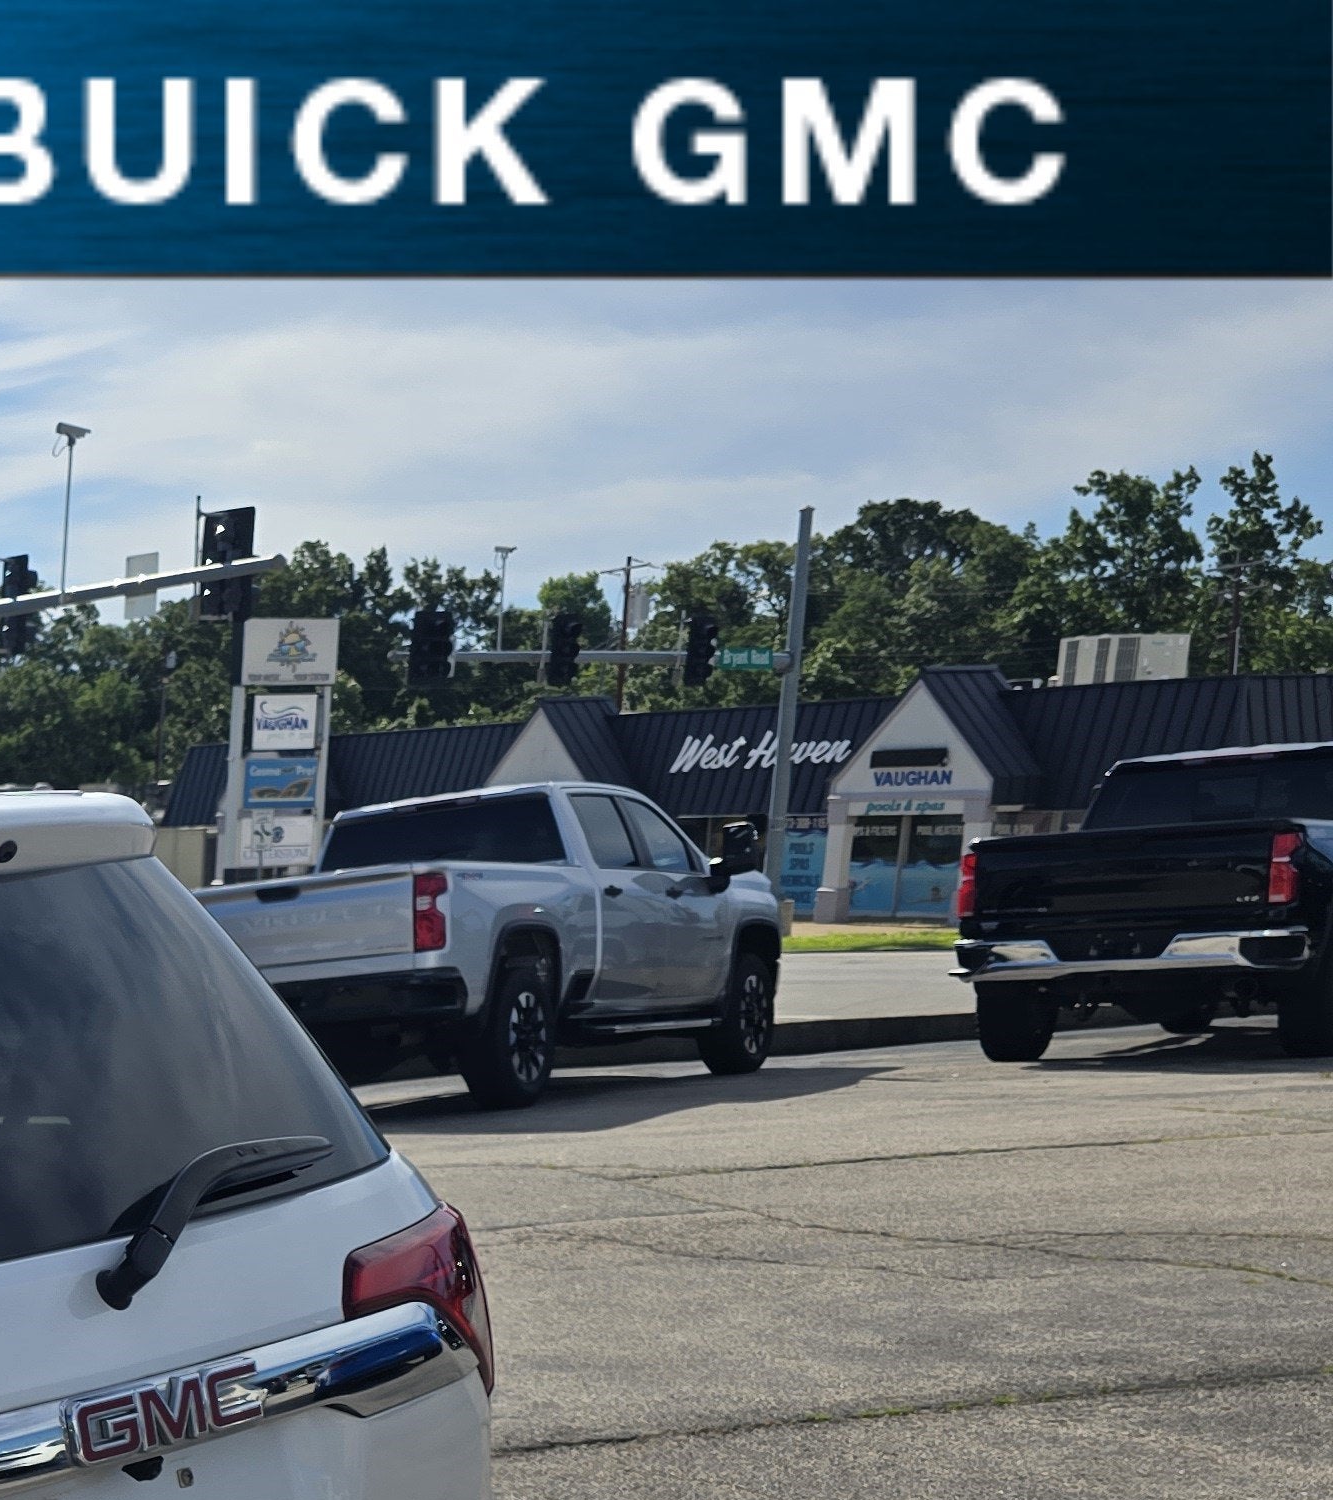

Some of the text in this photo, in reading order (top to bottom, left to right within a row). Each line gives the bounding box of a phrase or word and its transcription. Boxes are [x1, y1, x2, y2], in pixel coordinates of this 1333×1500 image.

[669, 730, 852, 773] West Hven
[873, 770, 953, 787] VAUGHAN
[865, 802, 902, 816] pools
[916, 802, 946, 815] spas
[66, 1357, 264, 1464] GMC
